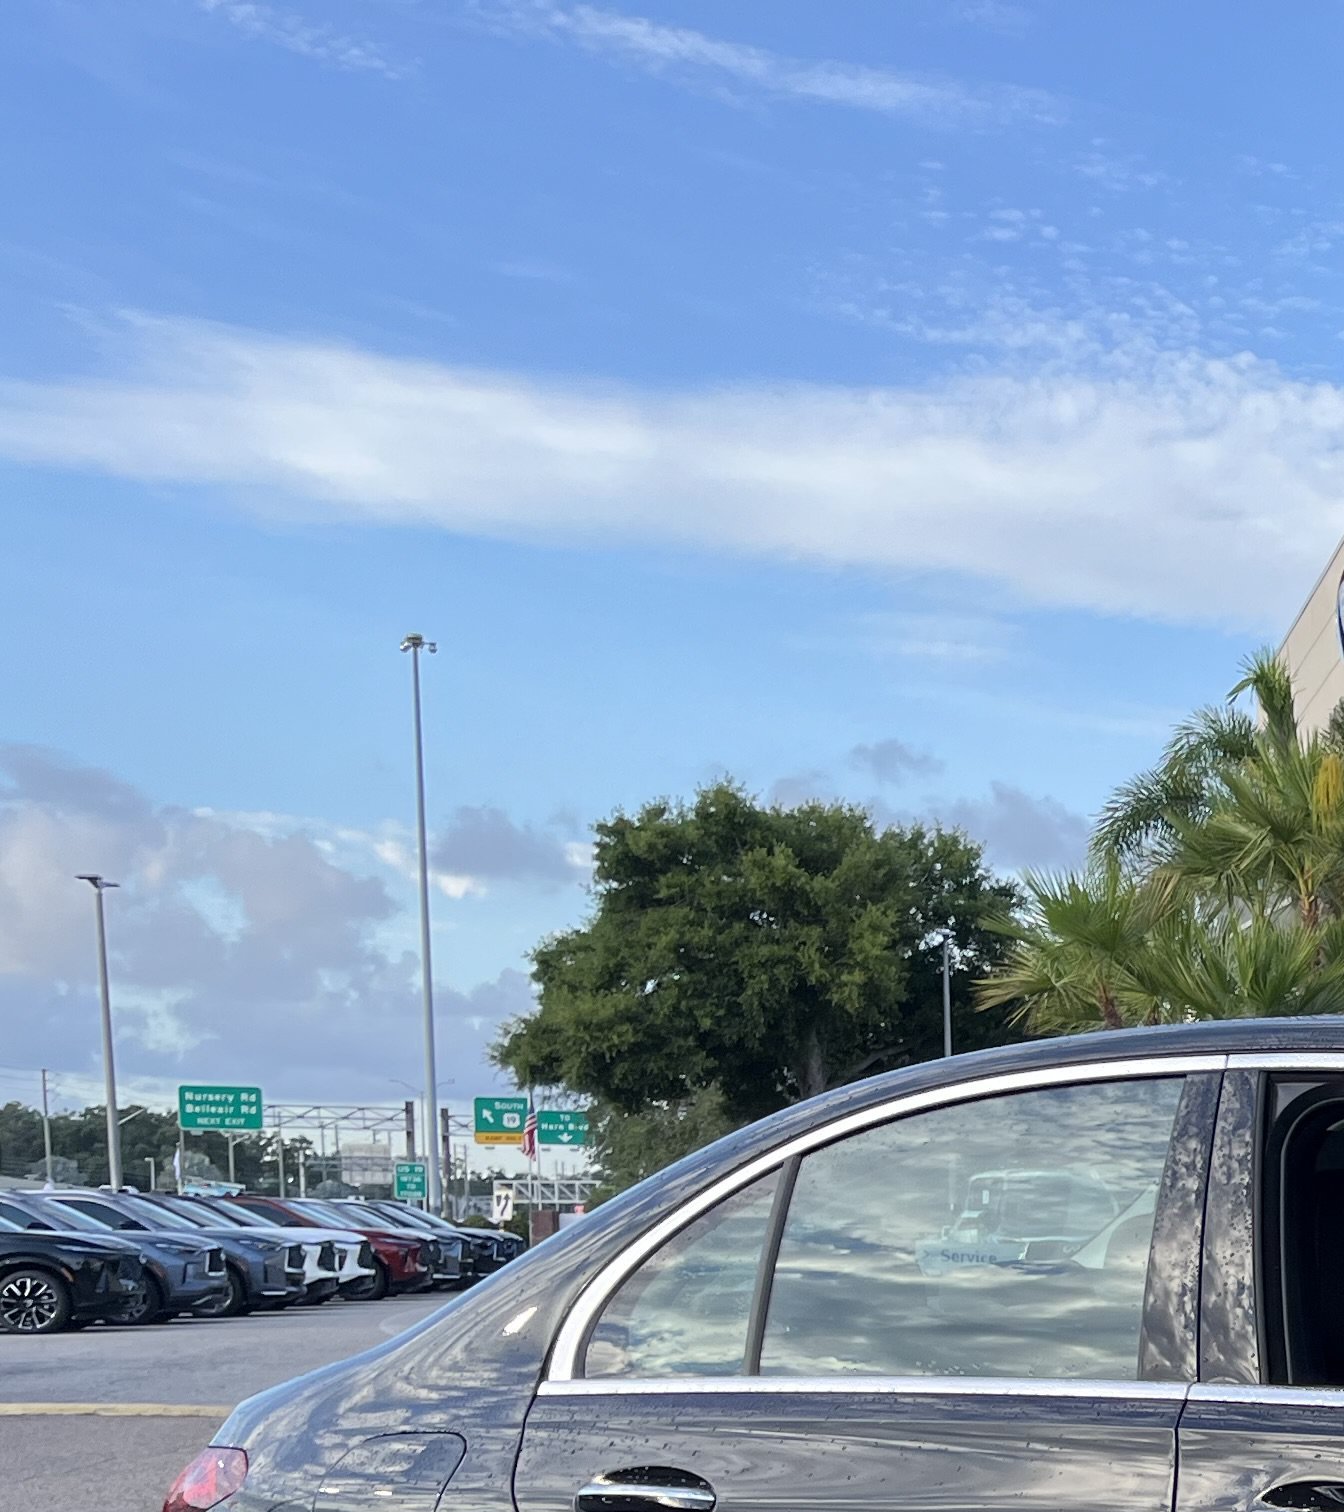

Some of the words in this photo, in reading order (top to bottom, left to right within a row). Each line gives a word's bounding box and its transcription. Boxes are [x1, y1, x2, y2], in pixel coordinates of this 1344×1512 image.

[184, 1091, 235, 1104] Nursery
[240, 1092, 257, 1103] Rd
[185, 1103, 235, 1114] Belleair
[240, 1104, 257, 1115] Rd
[494, 1101, 524, 1110] SOUTH
[196, 1117, 221, 1125] NEXT
[224, 1117, 246, 1126] EXIT
[940, 1249, 997, 1265] Service
